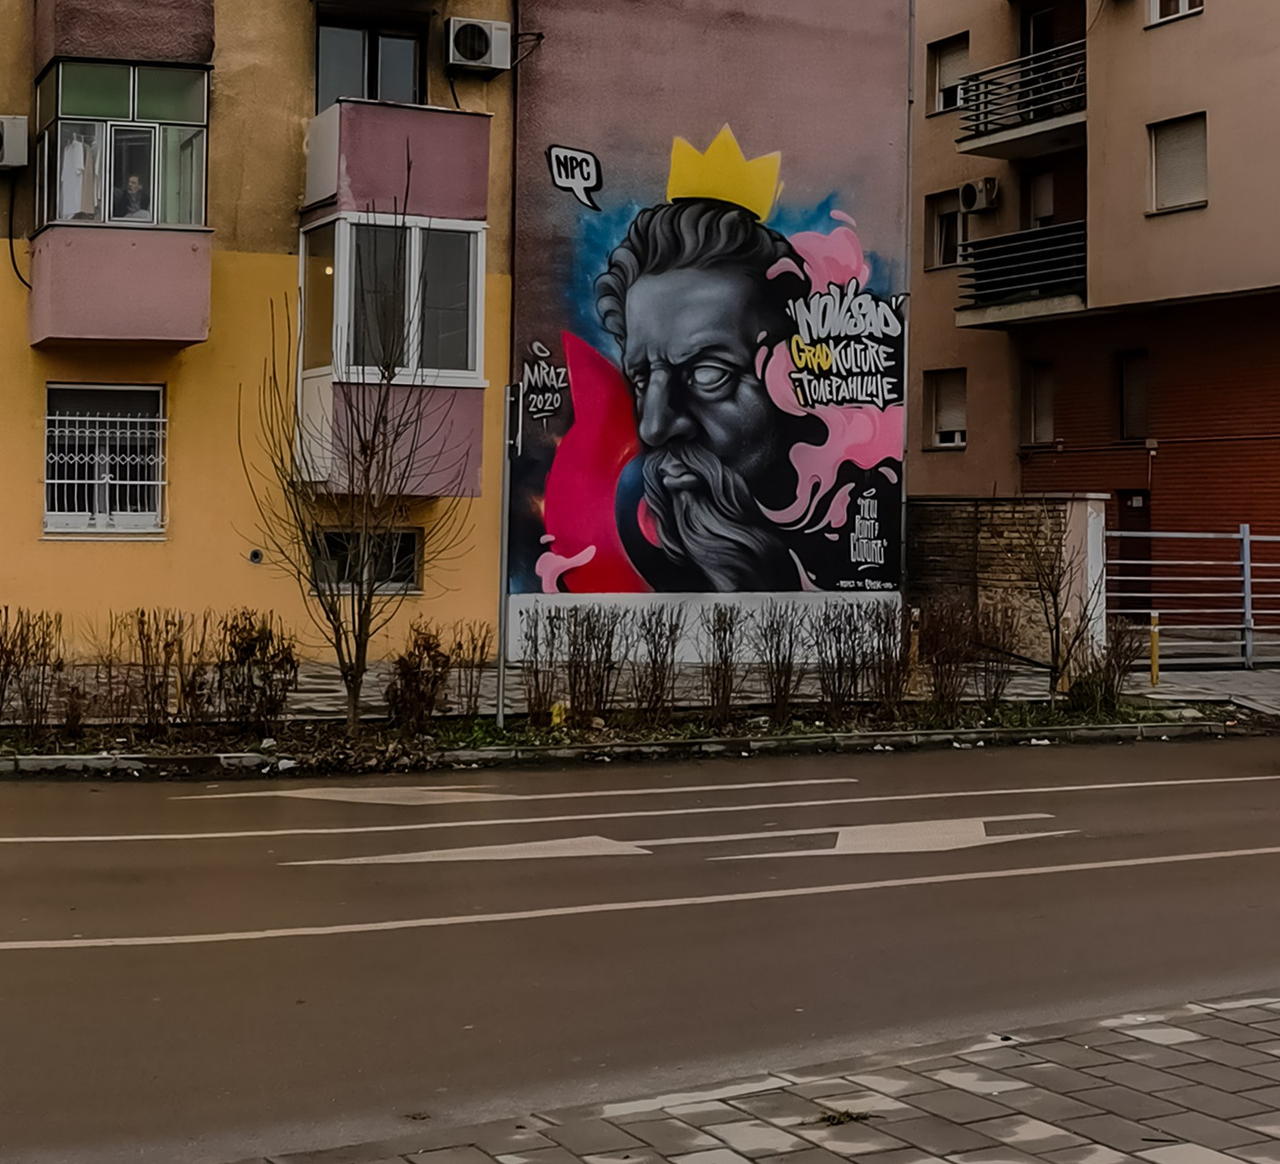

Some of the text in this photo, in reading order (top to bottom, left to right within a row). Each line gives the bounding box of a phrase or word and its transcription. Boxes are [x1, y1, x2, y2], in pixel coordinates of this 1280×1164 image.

[555, 154, 591, 182] NPC
[791, 334, 896, 376] GRAD KULTURE
[523, 360, 568, 394] MRAZ
[529, 393, 561, 412] 2020
